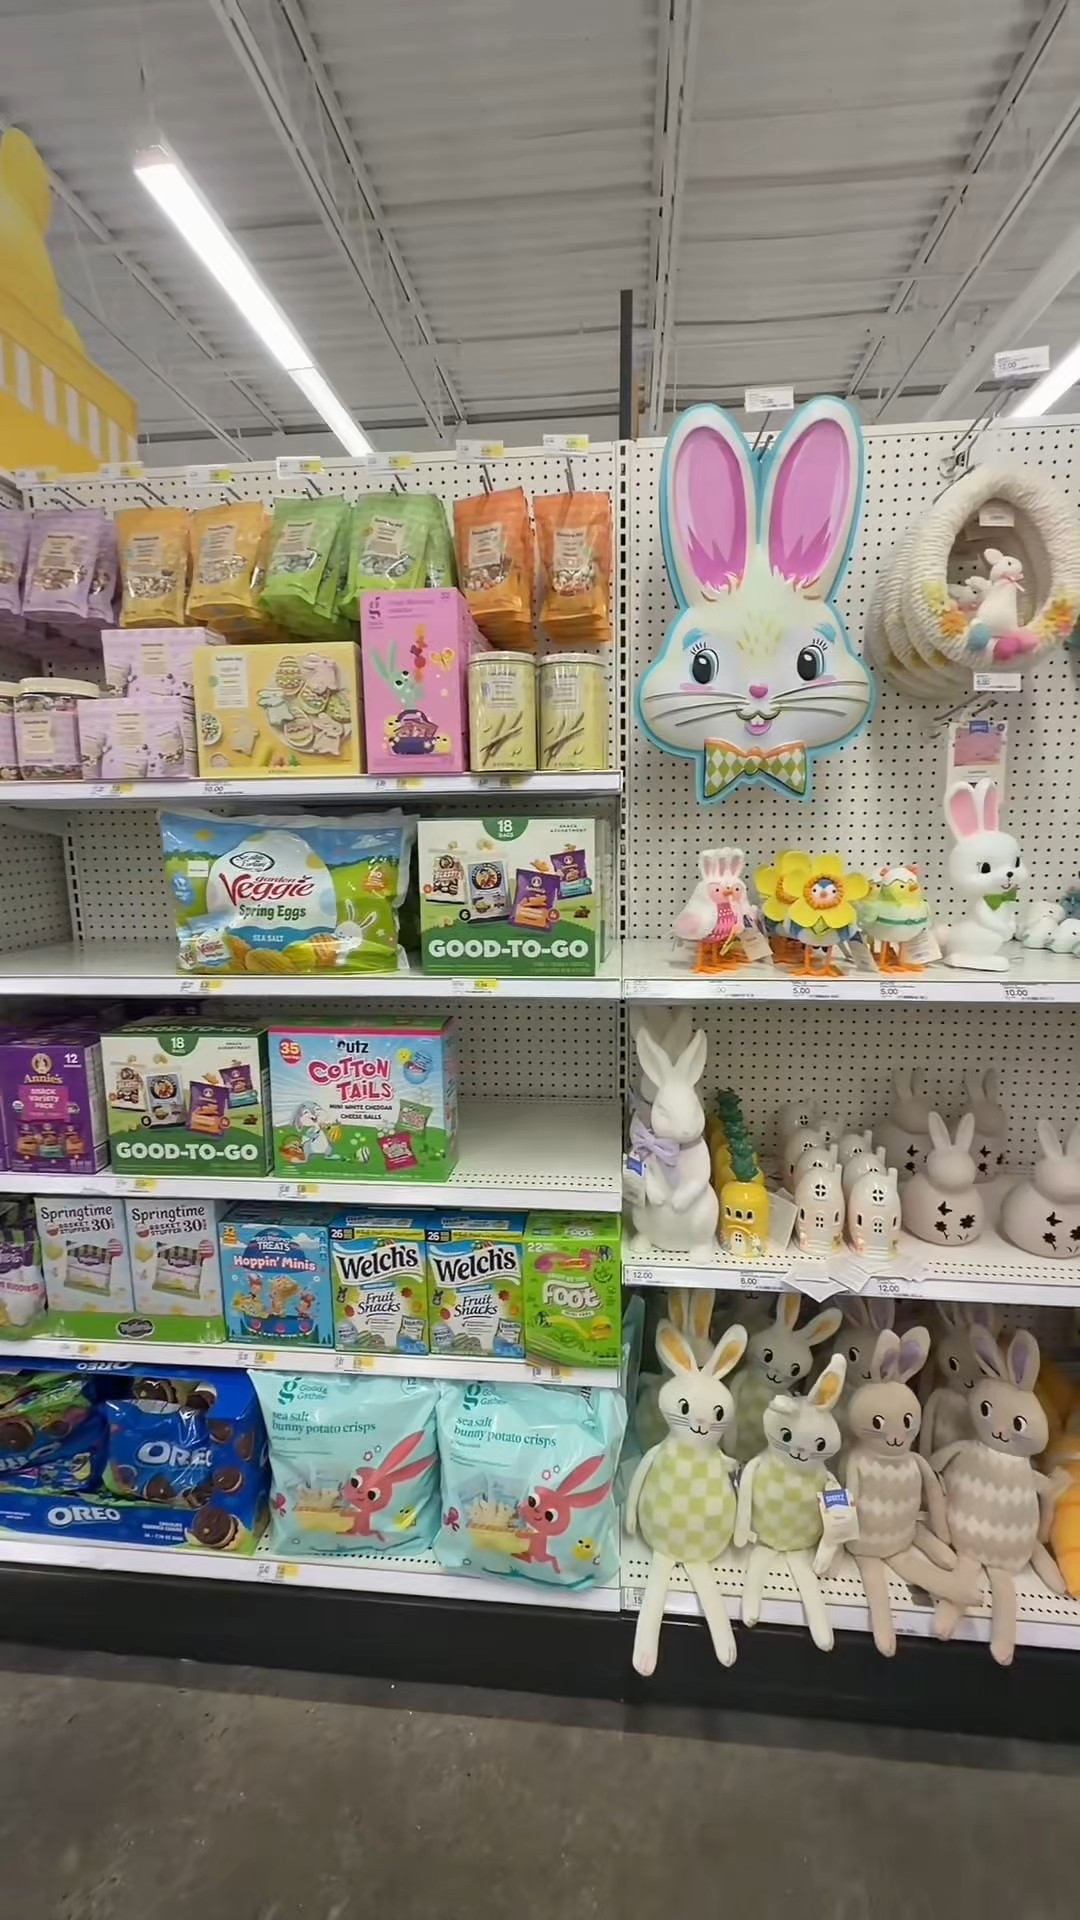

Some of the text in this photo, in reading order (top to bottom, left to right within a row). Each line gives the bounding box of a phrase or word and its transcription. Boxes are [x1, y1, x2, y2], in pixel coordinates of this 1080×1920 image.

[497, 819, 513, 832] 18
[219, 873, 314, 906] Veggie
[239, 904, 306, 920] Spring Eggs
[428, 939, 588, 958] GOOD-TO-GO
[792, 987, 810, 995] 5.00
[1005, 989, 1028, 997] 10.00
[170, 1037, 185, 1049] 18
[280, 1042, 300, 1055] 35
[64, 1053, 79, 1064] 12
[308, 1057, 389, 1083] COTTON
[24, 1073, 63, 1084] Annie's
[116, 1142, 258, 1161] GOOD-TO-GO
[40, 1205, 113, 1222] Springtime
[131, 1206, 205, 1223] Springtime
[91, 1218, 110, 1231] 30
[183, 1218, 202, 1232] 30
[331, 1229, 344, 1238] 26
[427, 1231, 440, 1241] 26
[257, 1241, 290, 1252] TREATS
[233, 1255, 317, 1271] Hoppin' Minis
[336, 1245, 418, 1280] Welch's
[433, 1248, 517, 1282] Welch's
[366, 1292, 396, 1305] Fruit
[462, 1294, 493, 1307] Fruit
[357, 1301, 401, 1315] Snacks
[454, 1304, 498, 1317] Snacks
[289, 1410, 309, 1422] salt
[475, 1416, 493, 1427] salt
[272, 1420, 376, 1435] bunny potato crisps
[453, 1425, 557, 1449] bunny potato crisps
[48, 1506, 121, 1525] OREO
